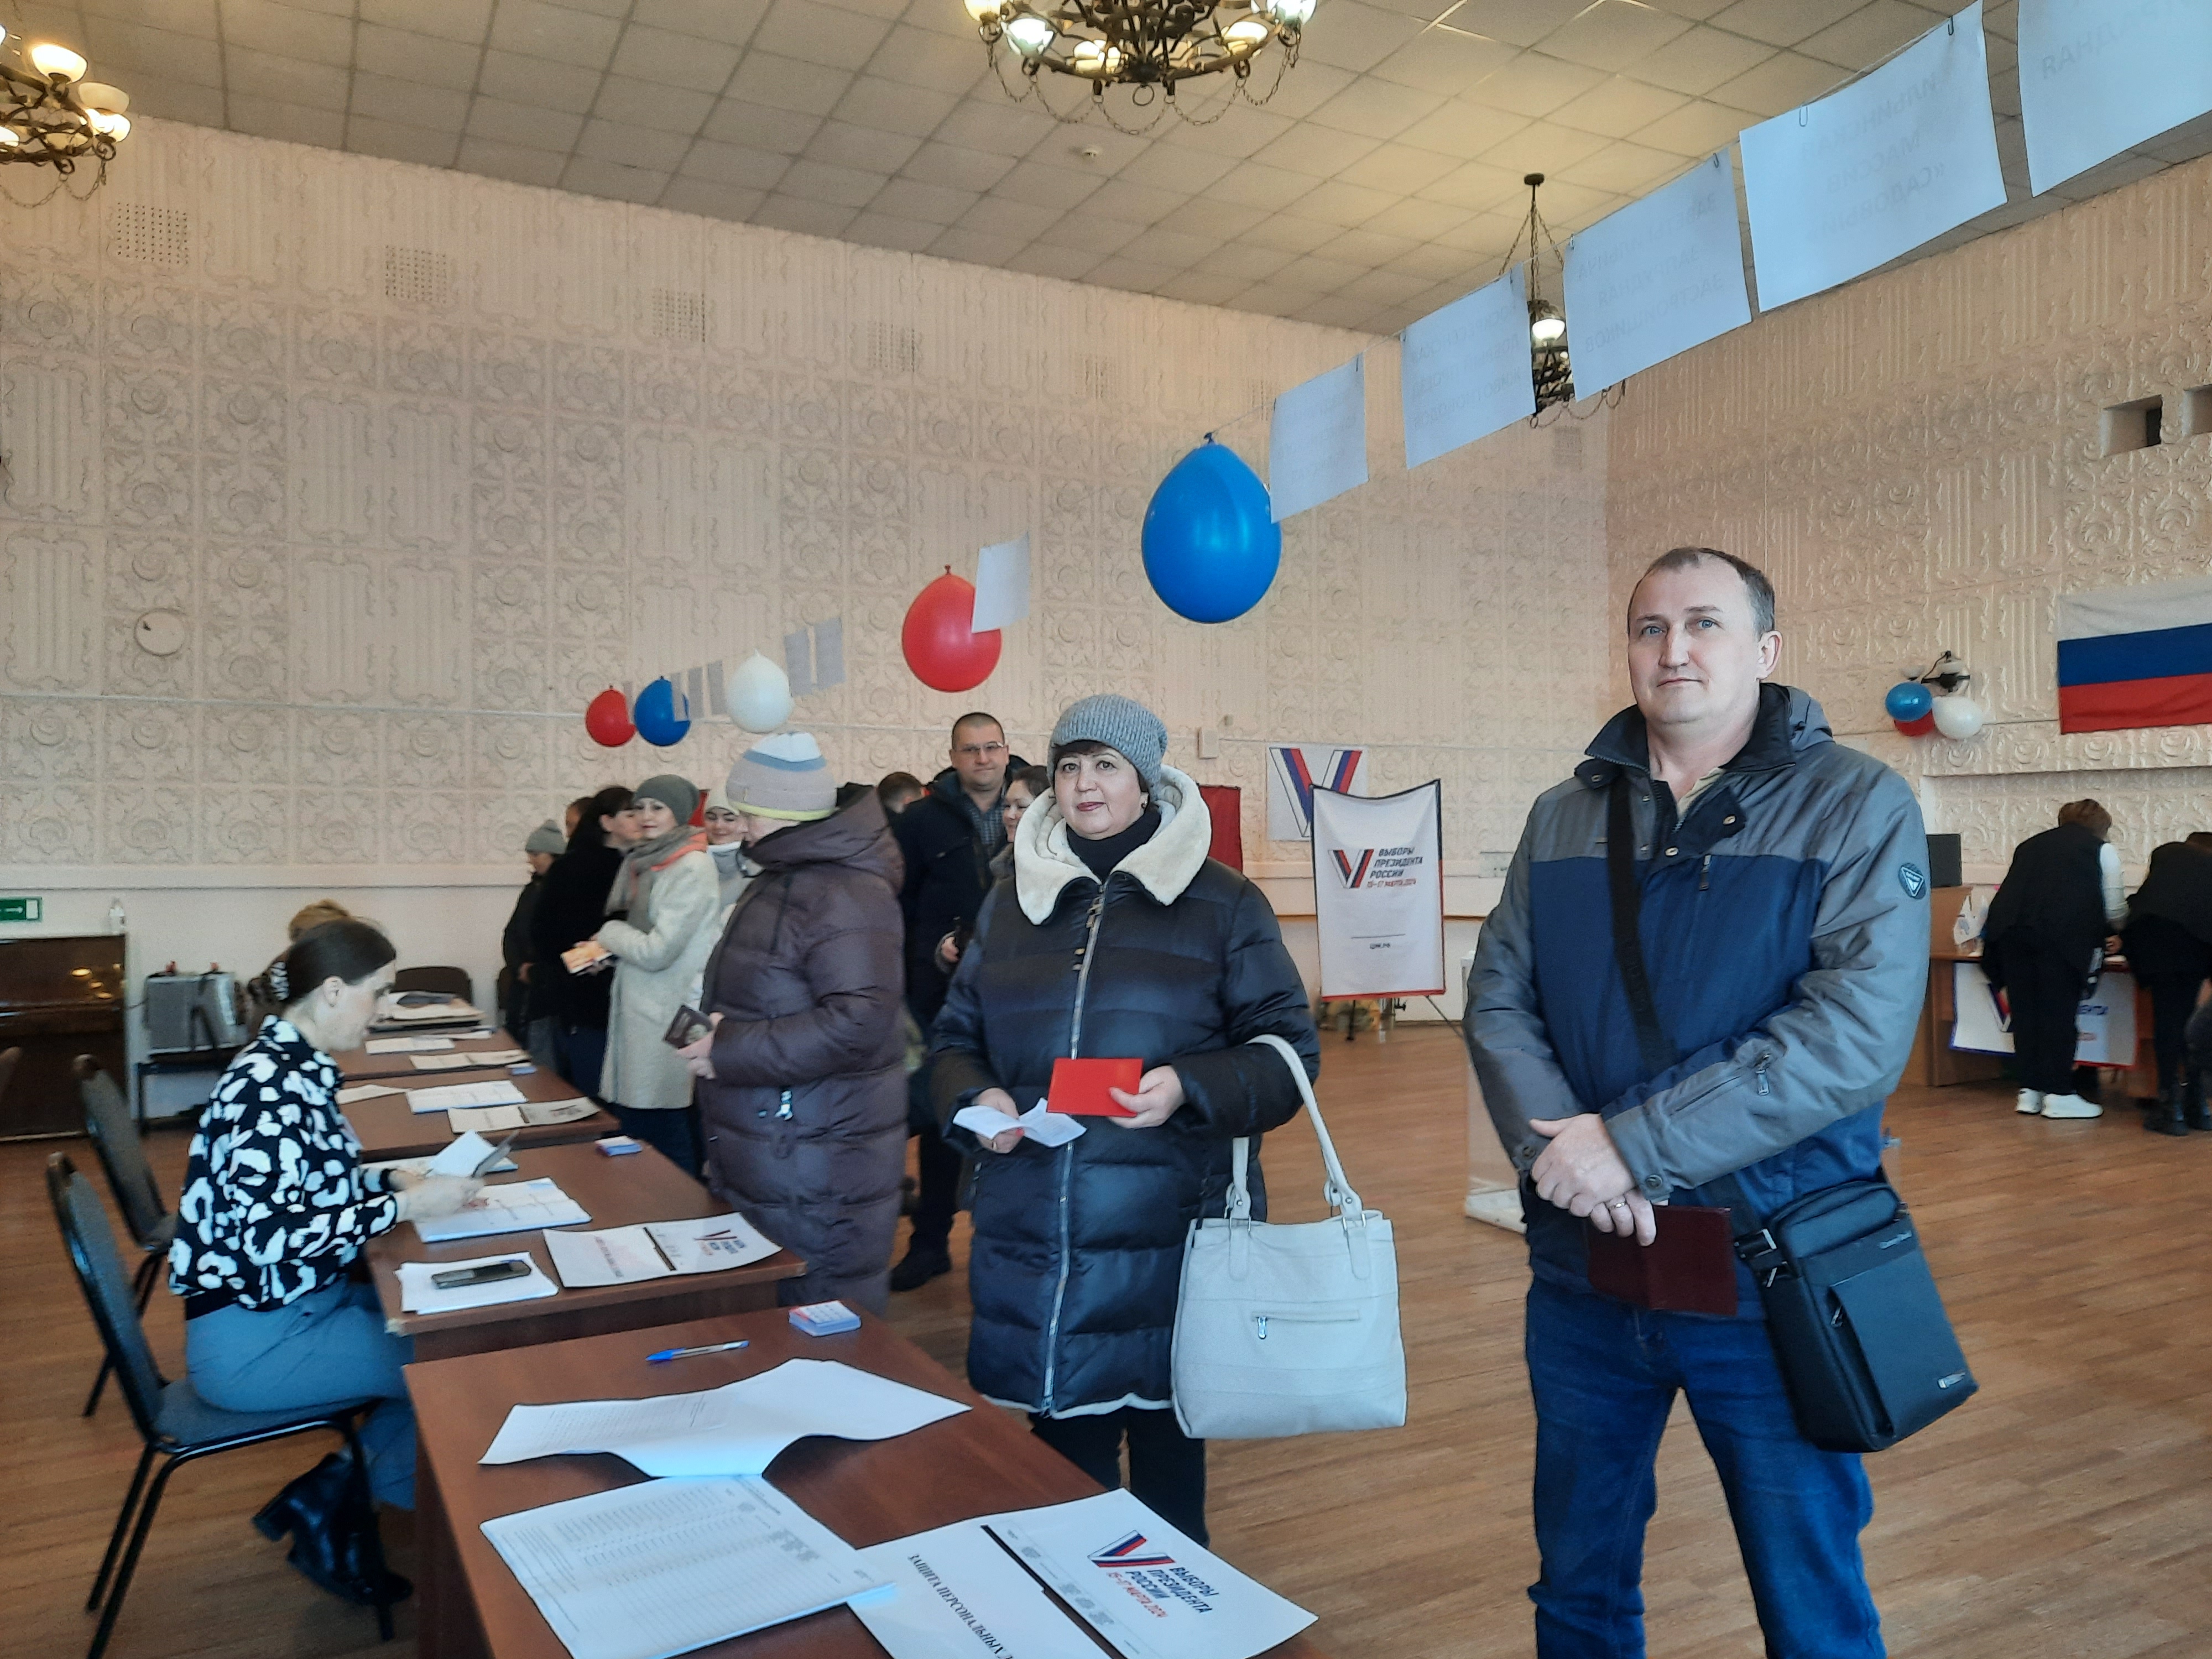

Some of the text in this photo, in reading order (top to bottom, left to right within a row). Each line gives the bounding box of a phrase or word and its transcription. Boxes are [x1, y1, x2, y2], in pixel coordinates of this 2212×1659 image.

[1369, 869, 1404, 879] РОССИИ
[907, 1553, 942, 1588] ЗАЩИТА
[1125, 1571, 1170, 1599] РОССИИ
[1169, 1567, 1219, 1597] ВЫБОРЫ
[1146, 1569, 1213, 1614] ПРЕЗИДЕНТА
